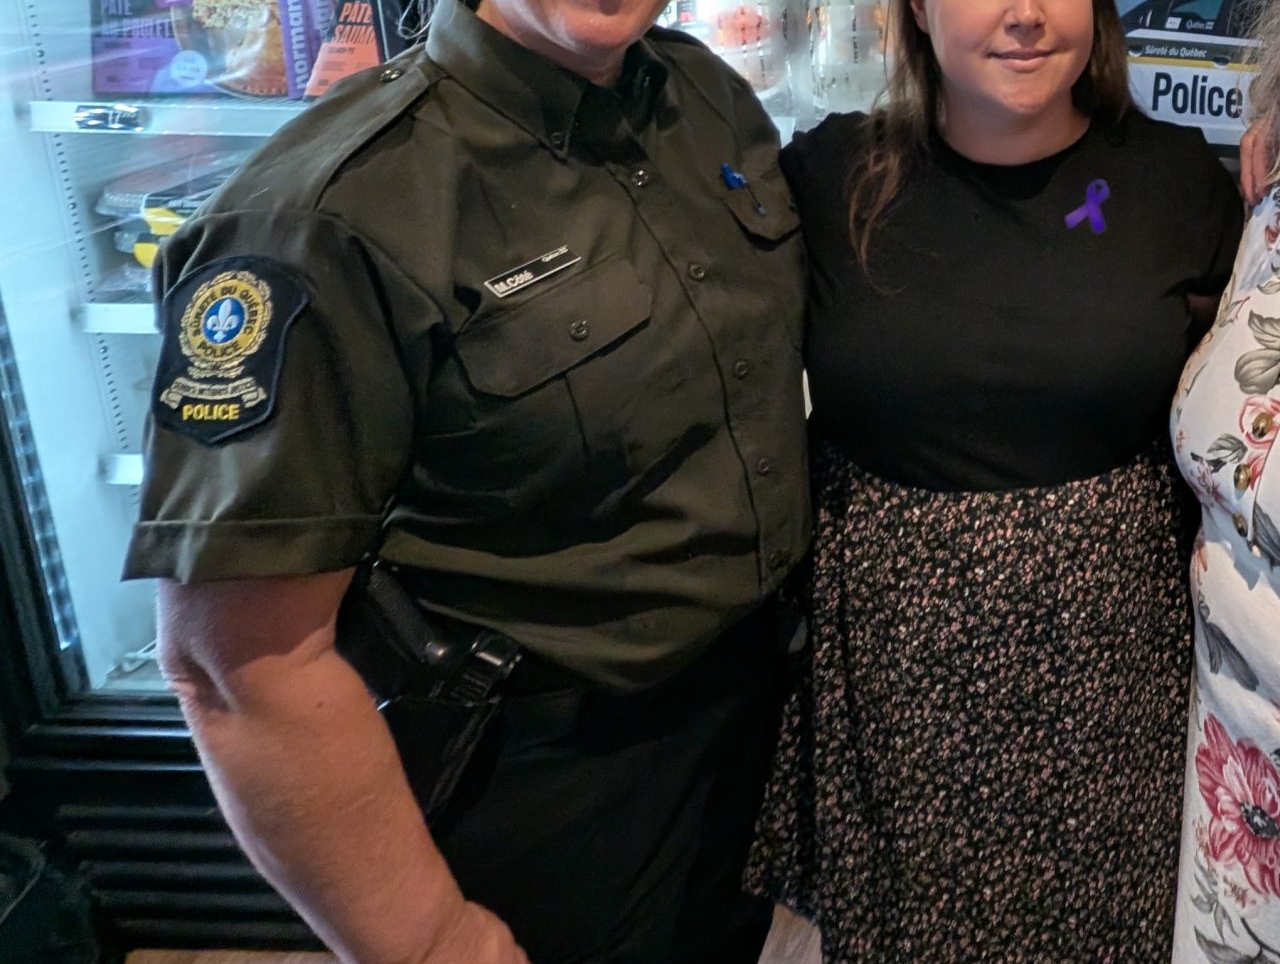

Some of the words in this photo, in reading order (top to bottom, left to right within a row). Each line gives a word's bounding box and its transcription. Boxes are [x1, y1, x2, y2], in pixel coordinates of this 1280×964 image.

[1145, 45, 1168, 56] Sûreté
[1168, 46, 1178, 56] du
[1180, 47, 1207, 58] Québec
[1152, 71, 1243, 118] Police
[220, 286, 237, 296] DU
[182, 404, 241, 421] POLICE
